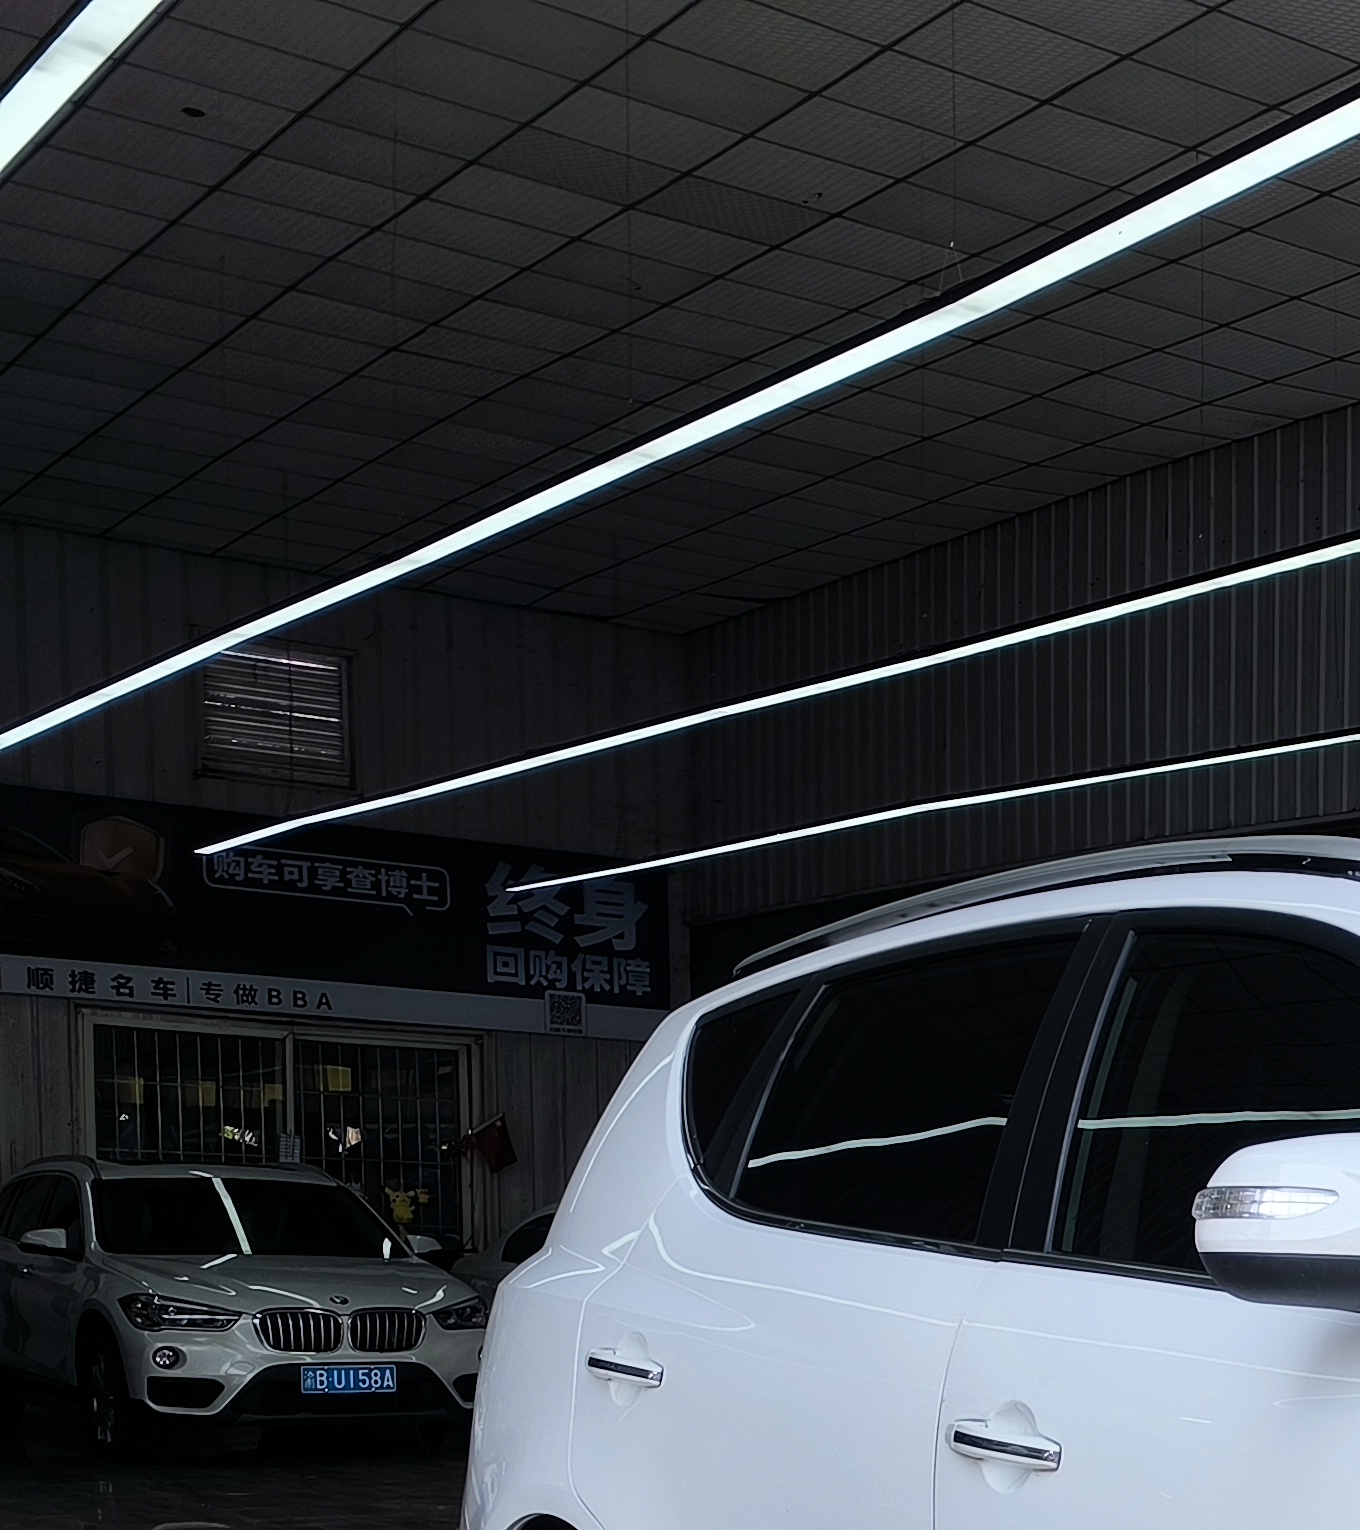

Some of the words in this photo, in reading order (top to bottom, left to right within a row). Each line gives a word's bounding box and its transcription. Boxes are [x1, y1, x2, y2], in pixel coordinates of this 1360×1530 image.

[212, 852, 442, 903] 购车可享查博士
[26, 966, 177, 1004] 顺捷名车
[485, 945, 651, 996] 回购保障
